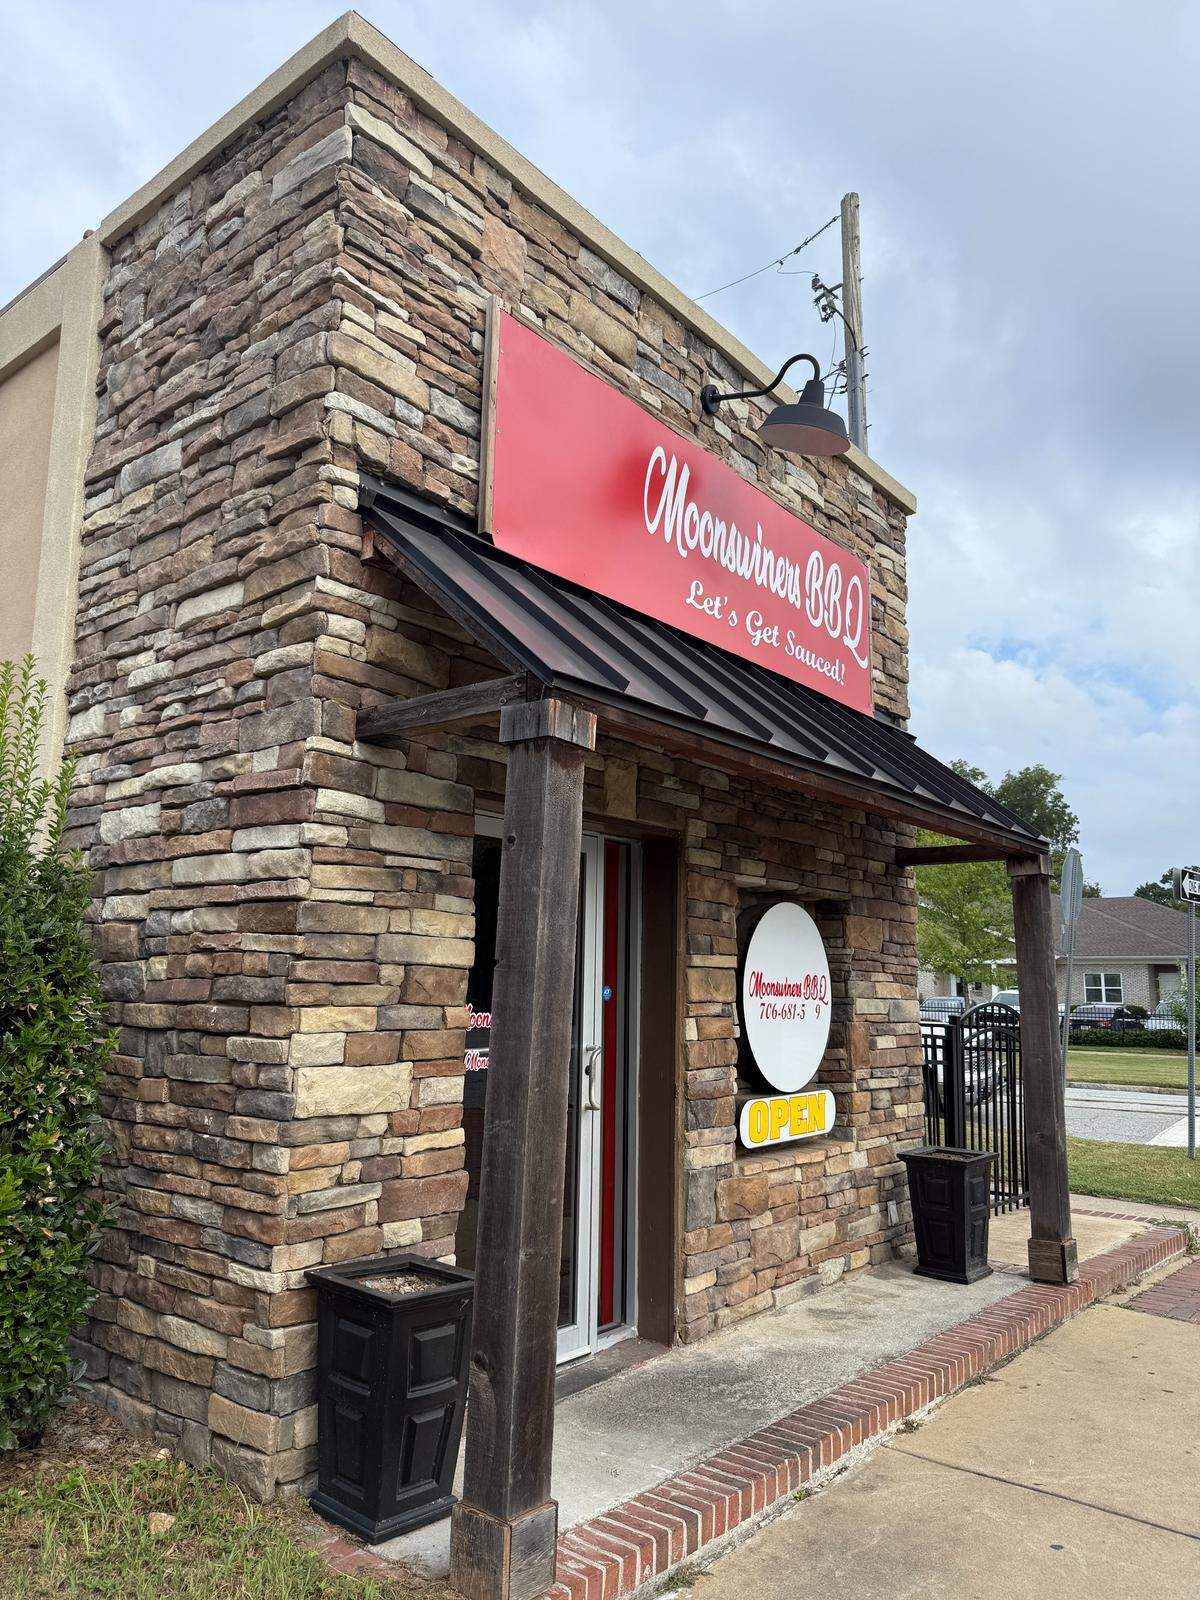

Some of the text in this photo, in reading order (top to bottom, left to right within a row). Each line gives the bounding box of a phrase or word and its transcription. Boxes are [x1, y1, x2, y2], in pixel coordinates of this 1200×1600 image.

[644, 446, 868, 669] Moonswiners BBQ
[685, 580, 846, 687] Let's Get Sauced!
[749, 971, 829, 1005] Moonswiners BBQ
[748, 1092, 827, 1144] OPEN
